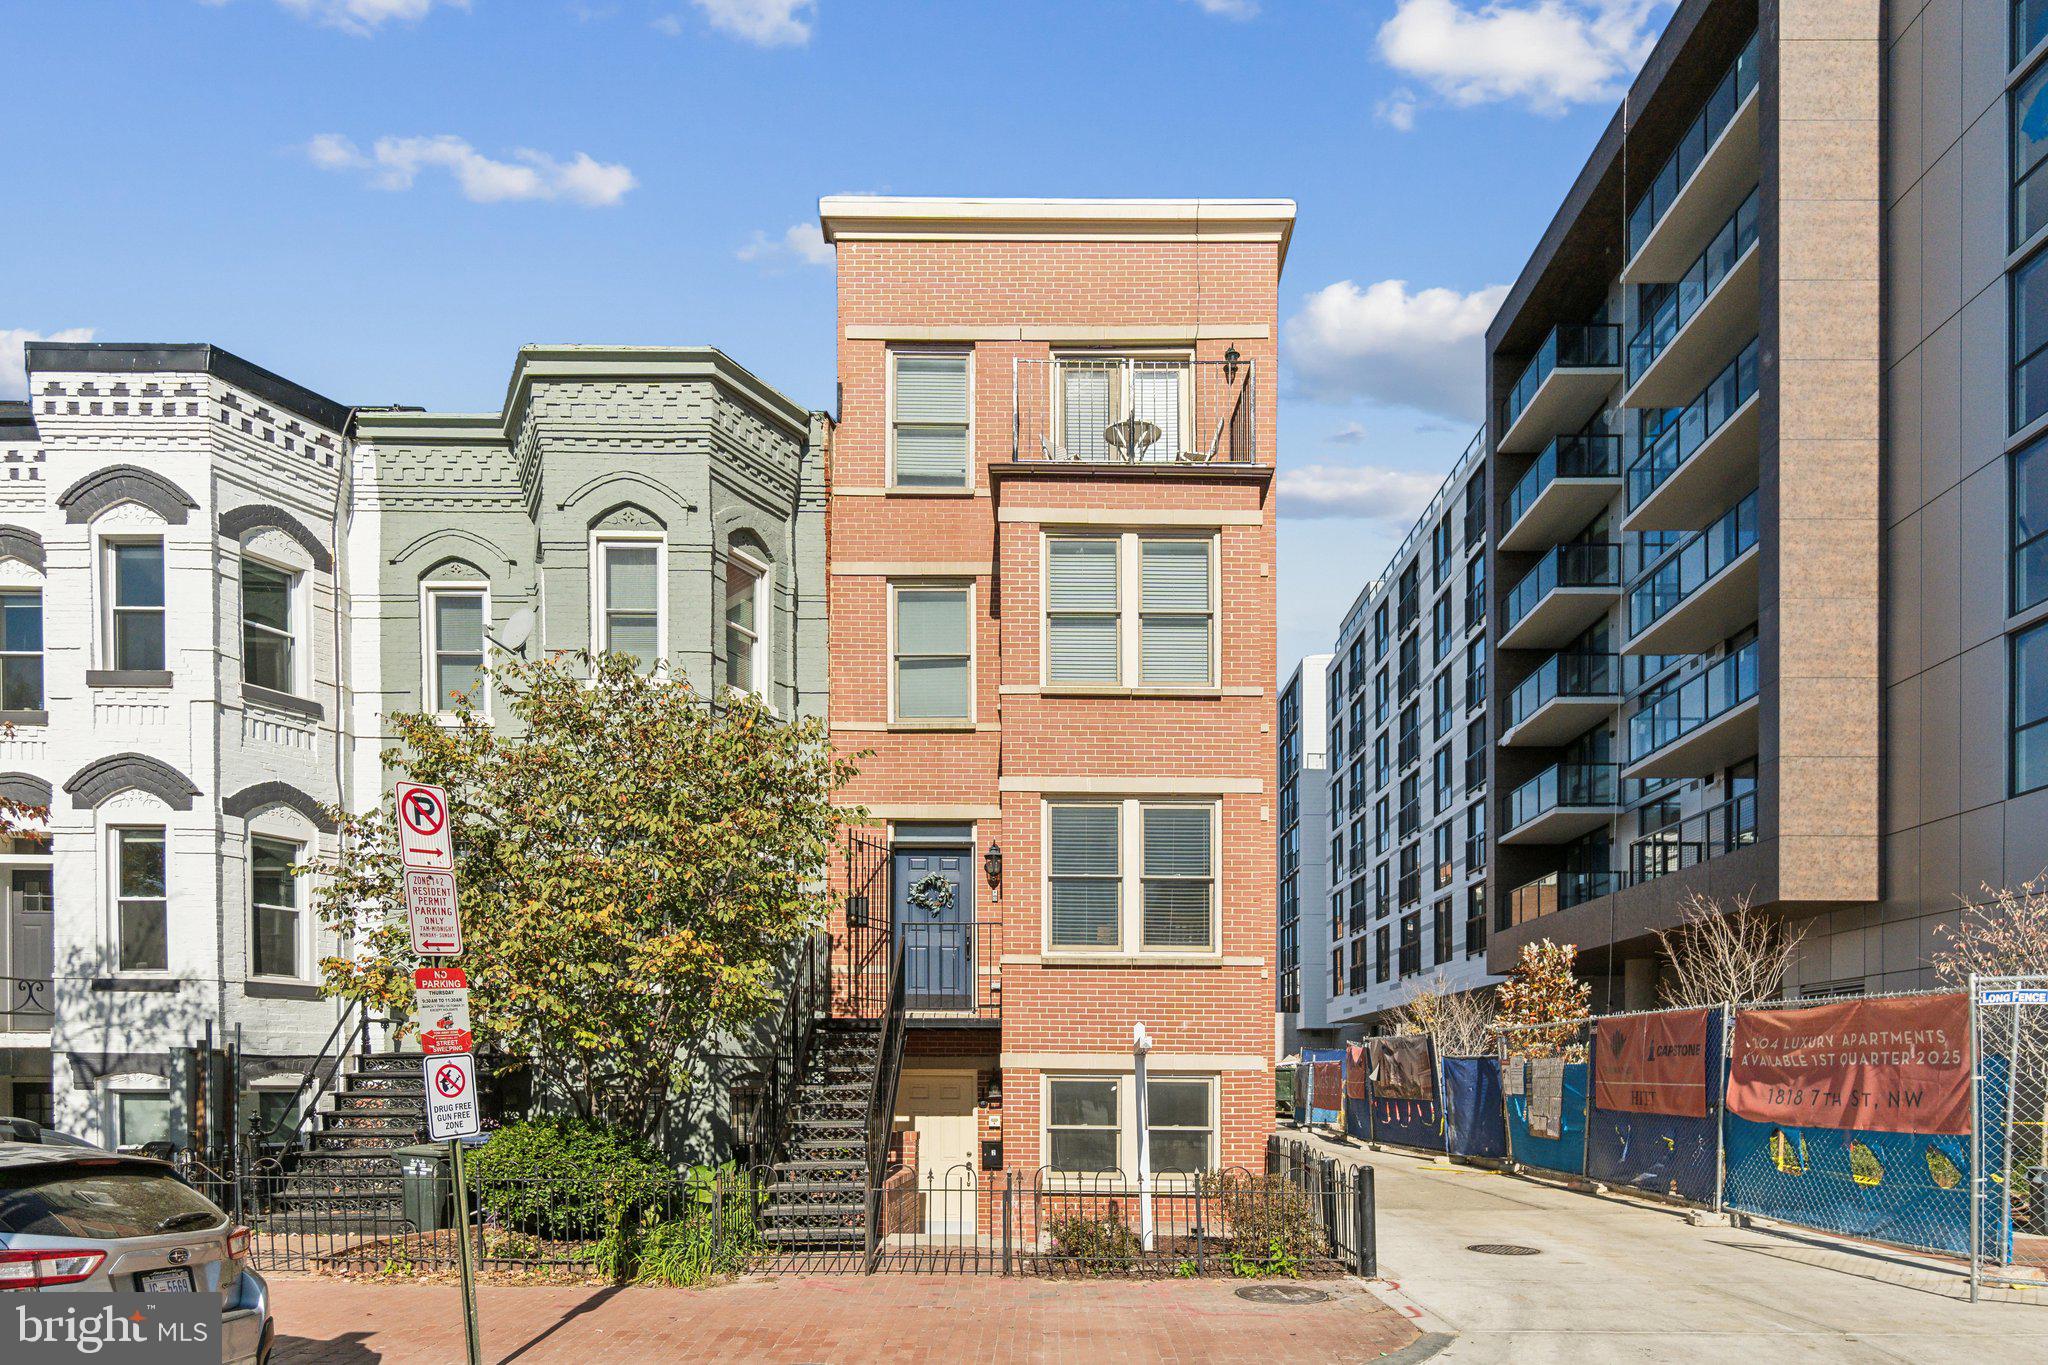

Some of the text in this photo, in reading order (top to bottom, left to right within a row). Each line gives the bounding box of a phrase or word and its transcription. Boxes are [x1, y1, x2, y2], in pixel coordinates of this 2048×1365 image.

[413, 876, 431, 886] ZONE
[412, 887, 451, 897] RESIDENT
[418, 896, 447, 906] PERMIT
[415, 906, 453, 916] PARKING
[424, 916, 444, 925] ONLY
[433, 970, 448, 979] NO
[421, 979, 461, 988] PARKING
[1983, 991, 2047, 1003] LONG FENCE
[435, 1039, 458, 1047] STREET
[1783, 1034, 1834, 1050] LUXURY
[1656, 1043, 1701, 1057] CAPSTONE
[1741, 1050, 1961, 1067] AVAILABLE 1ST QUARTER 2025
[1768, 1088, 1804, 1105] 1818
[1850, 1089, 1879, 1109] ST,
[1888, 1090, 1924, 1108] NW
[433, 1102, 472, 1113] DRUG FREE
[437, 1111, 471, 1121] GUN FREE
[445, 1120, 464, 1130] ZONE
